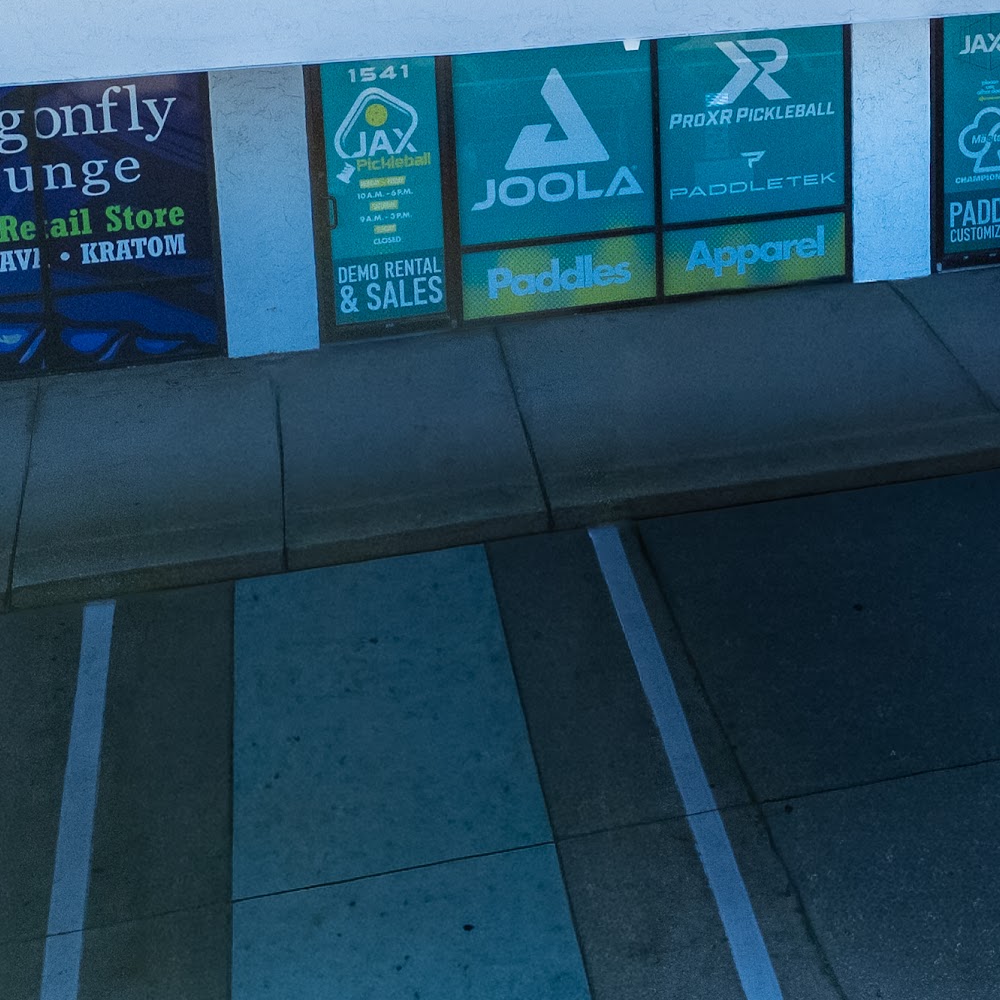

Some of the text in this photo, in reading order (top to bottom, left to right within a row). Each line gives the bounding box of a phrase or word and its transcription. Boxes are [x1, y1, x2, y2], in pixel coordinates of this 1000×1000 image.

[348, 64, 409, 83] 1541
[0, 83, 177, 155] gonfly
[347, 128, 418, 159] JAX
[4, 156, 141, 196] unge
[356, 152, 432, 172] Pickleball
[471, 165, 645, 212] JOOLA
[669, 172, 836, 200] PADDLETEK
[0, 205, 185, 243] Reail Store
[373, 235, 402, 245] CLOSED
[81, 232, 187, 265] KRATOM
[685, 225, 825, 278] Apparel
[338, 256, 442, 284] DEMO RENTAL
[487, 254, 632, 300] Paddles
[340, 276, 444, 314] & SALES
